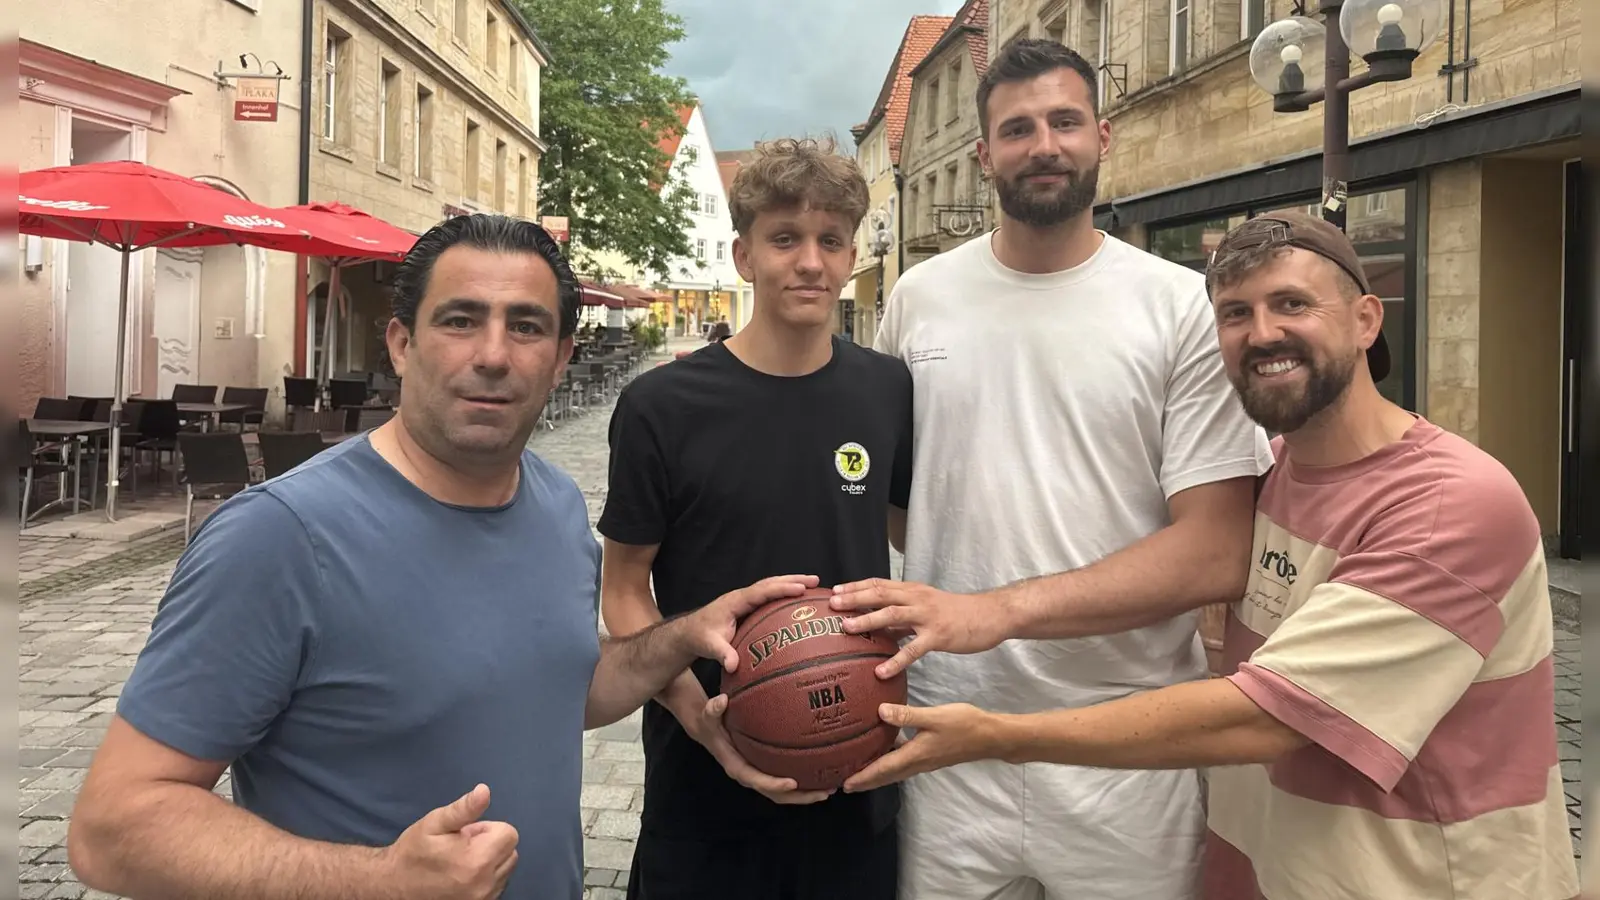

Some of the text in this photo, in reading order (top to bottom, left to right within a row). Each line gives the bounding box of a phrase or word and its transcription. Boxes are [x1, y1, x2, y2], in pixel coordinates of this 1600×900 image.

[245, 88, 274, 98] PLAKA
[841, 482, 866, 494] cybex
[808, 684, 846, 709] NBA
